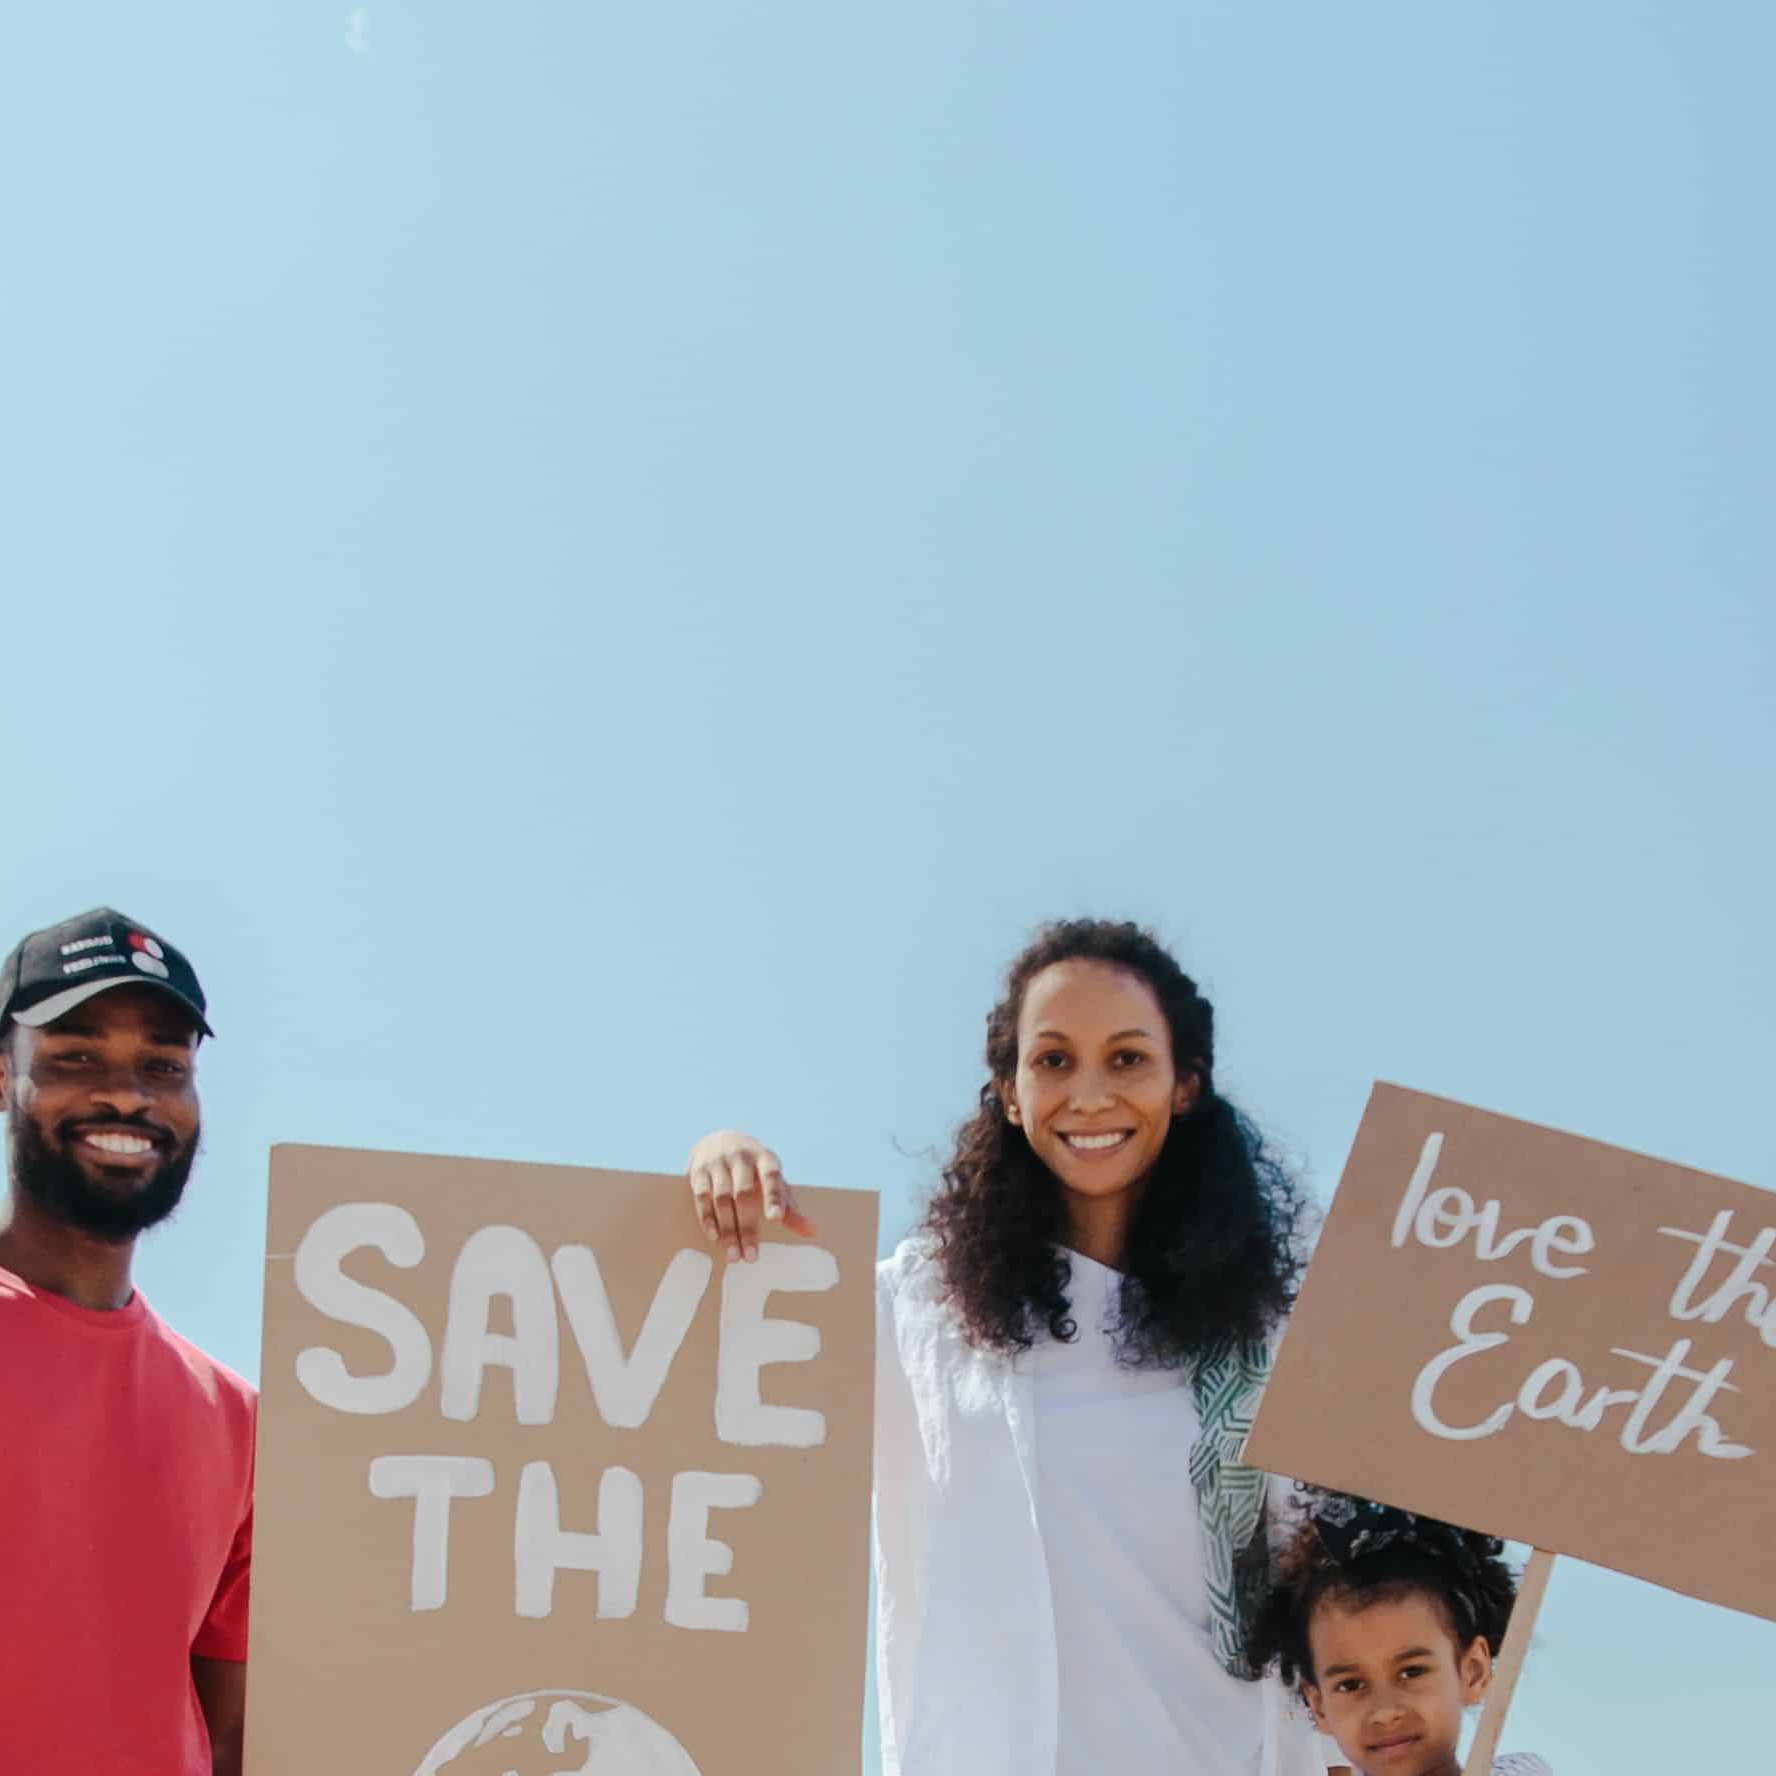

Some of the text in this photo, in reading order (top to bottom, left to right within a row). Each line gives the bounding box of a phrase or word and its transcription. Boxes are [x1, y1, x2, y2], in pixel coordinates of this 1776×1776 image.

[1390, 1131, 1596, 1280] love
[293, 1201, 841, 1448] SAVE
[1410, 1283, 1756, 1460] Earth
[368, 1454, 764, 1633] THE
